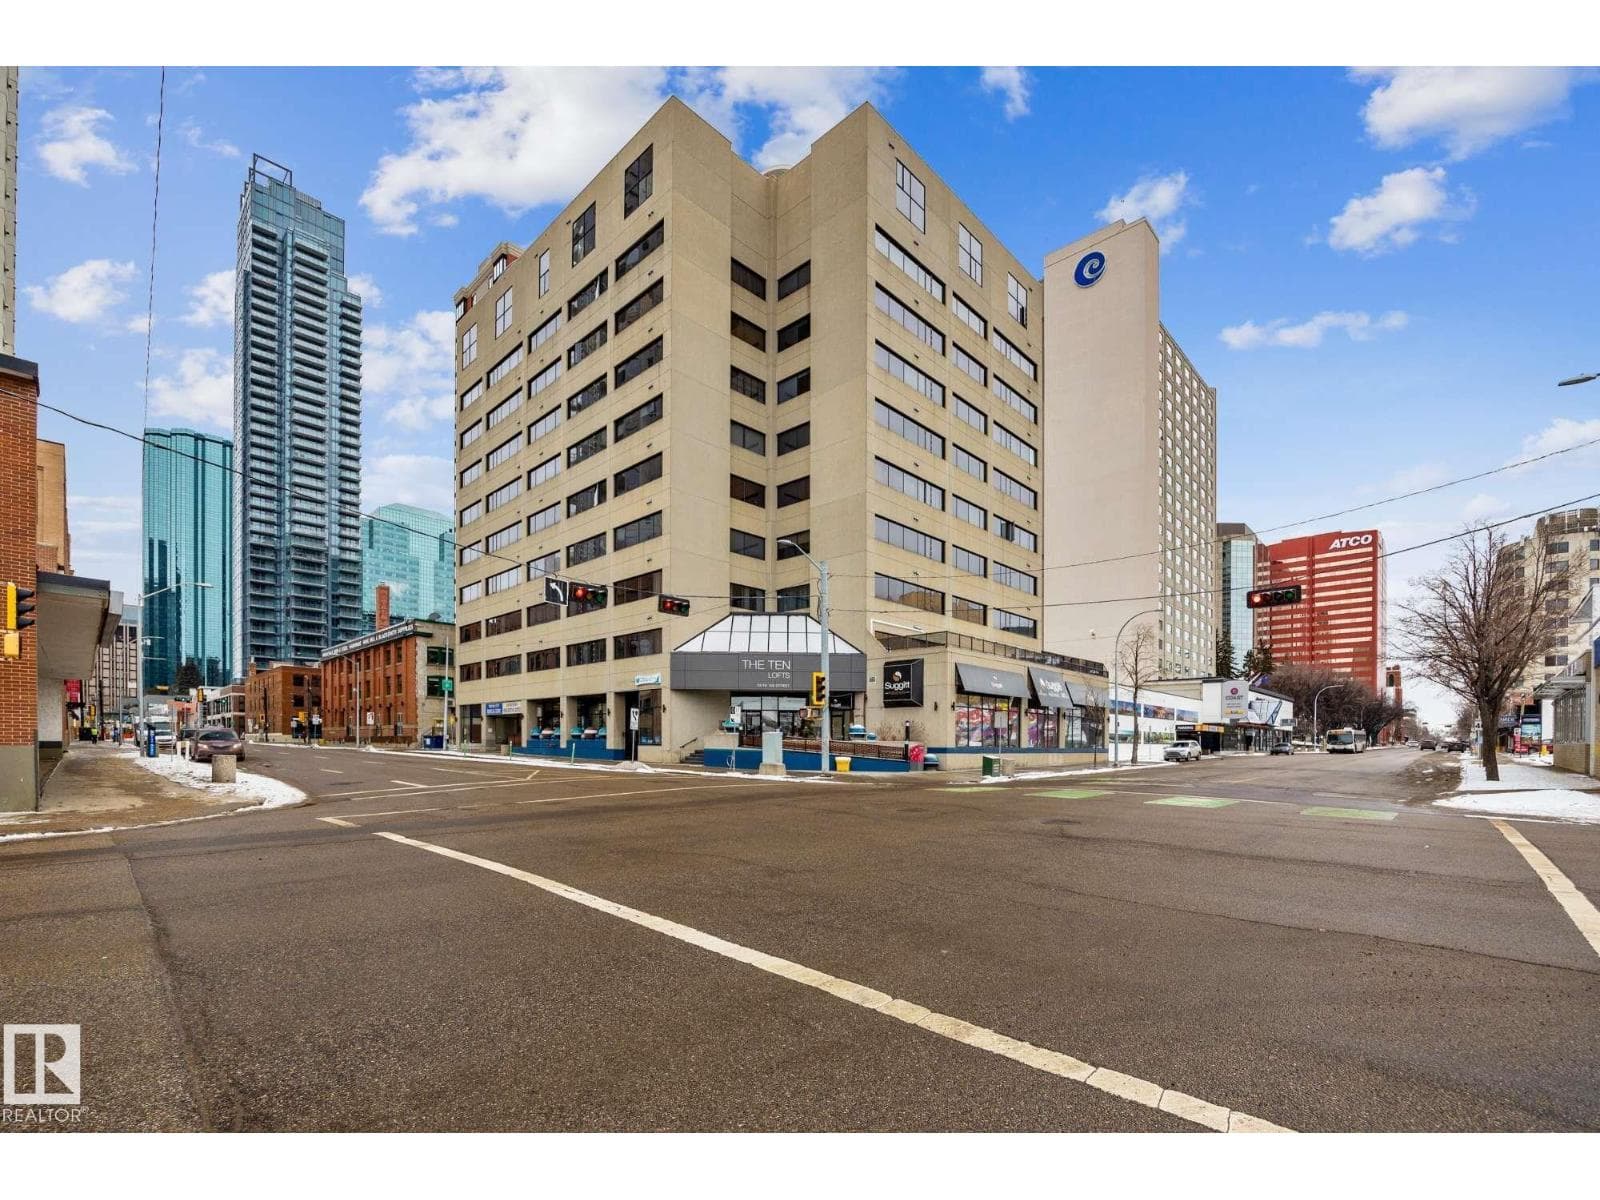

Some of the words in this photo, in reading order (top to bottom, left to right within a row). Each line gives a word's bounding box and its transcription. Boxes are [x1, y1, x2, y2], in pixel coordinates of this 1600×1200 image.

[1329, 535, 1373, 550] ATCO
[741, 659, 765, 670] THE
[767, 659, 791, 670] TEN
[767, 671, 791, 679] LOFTS
